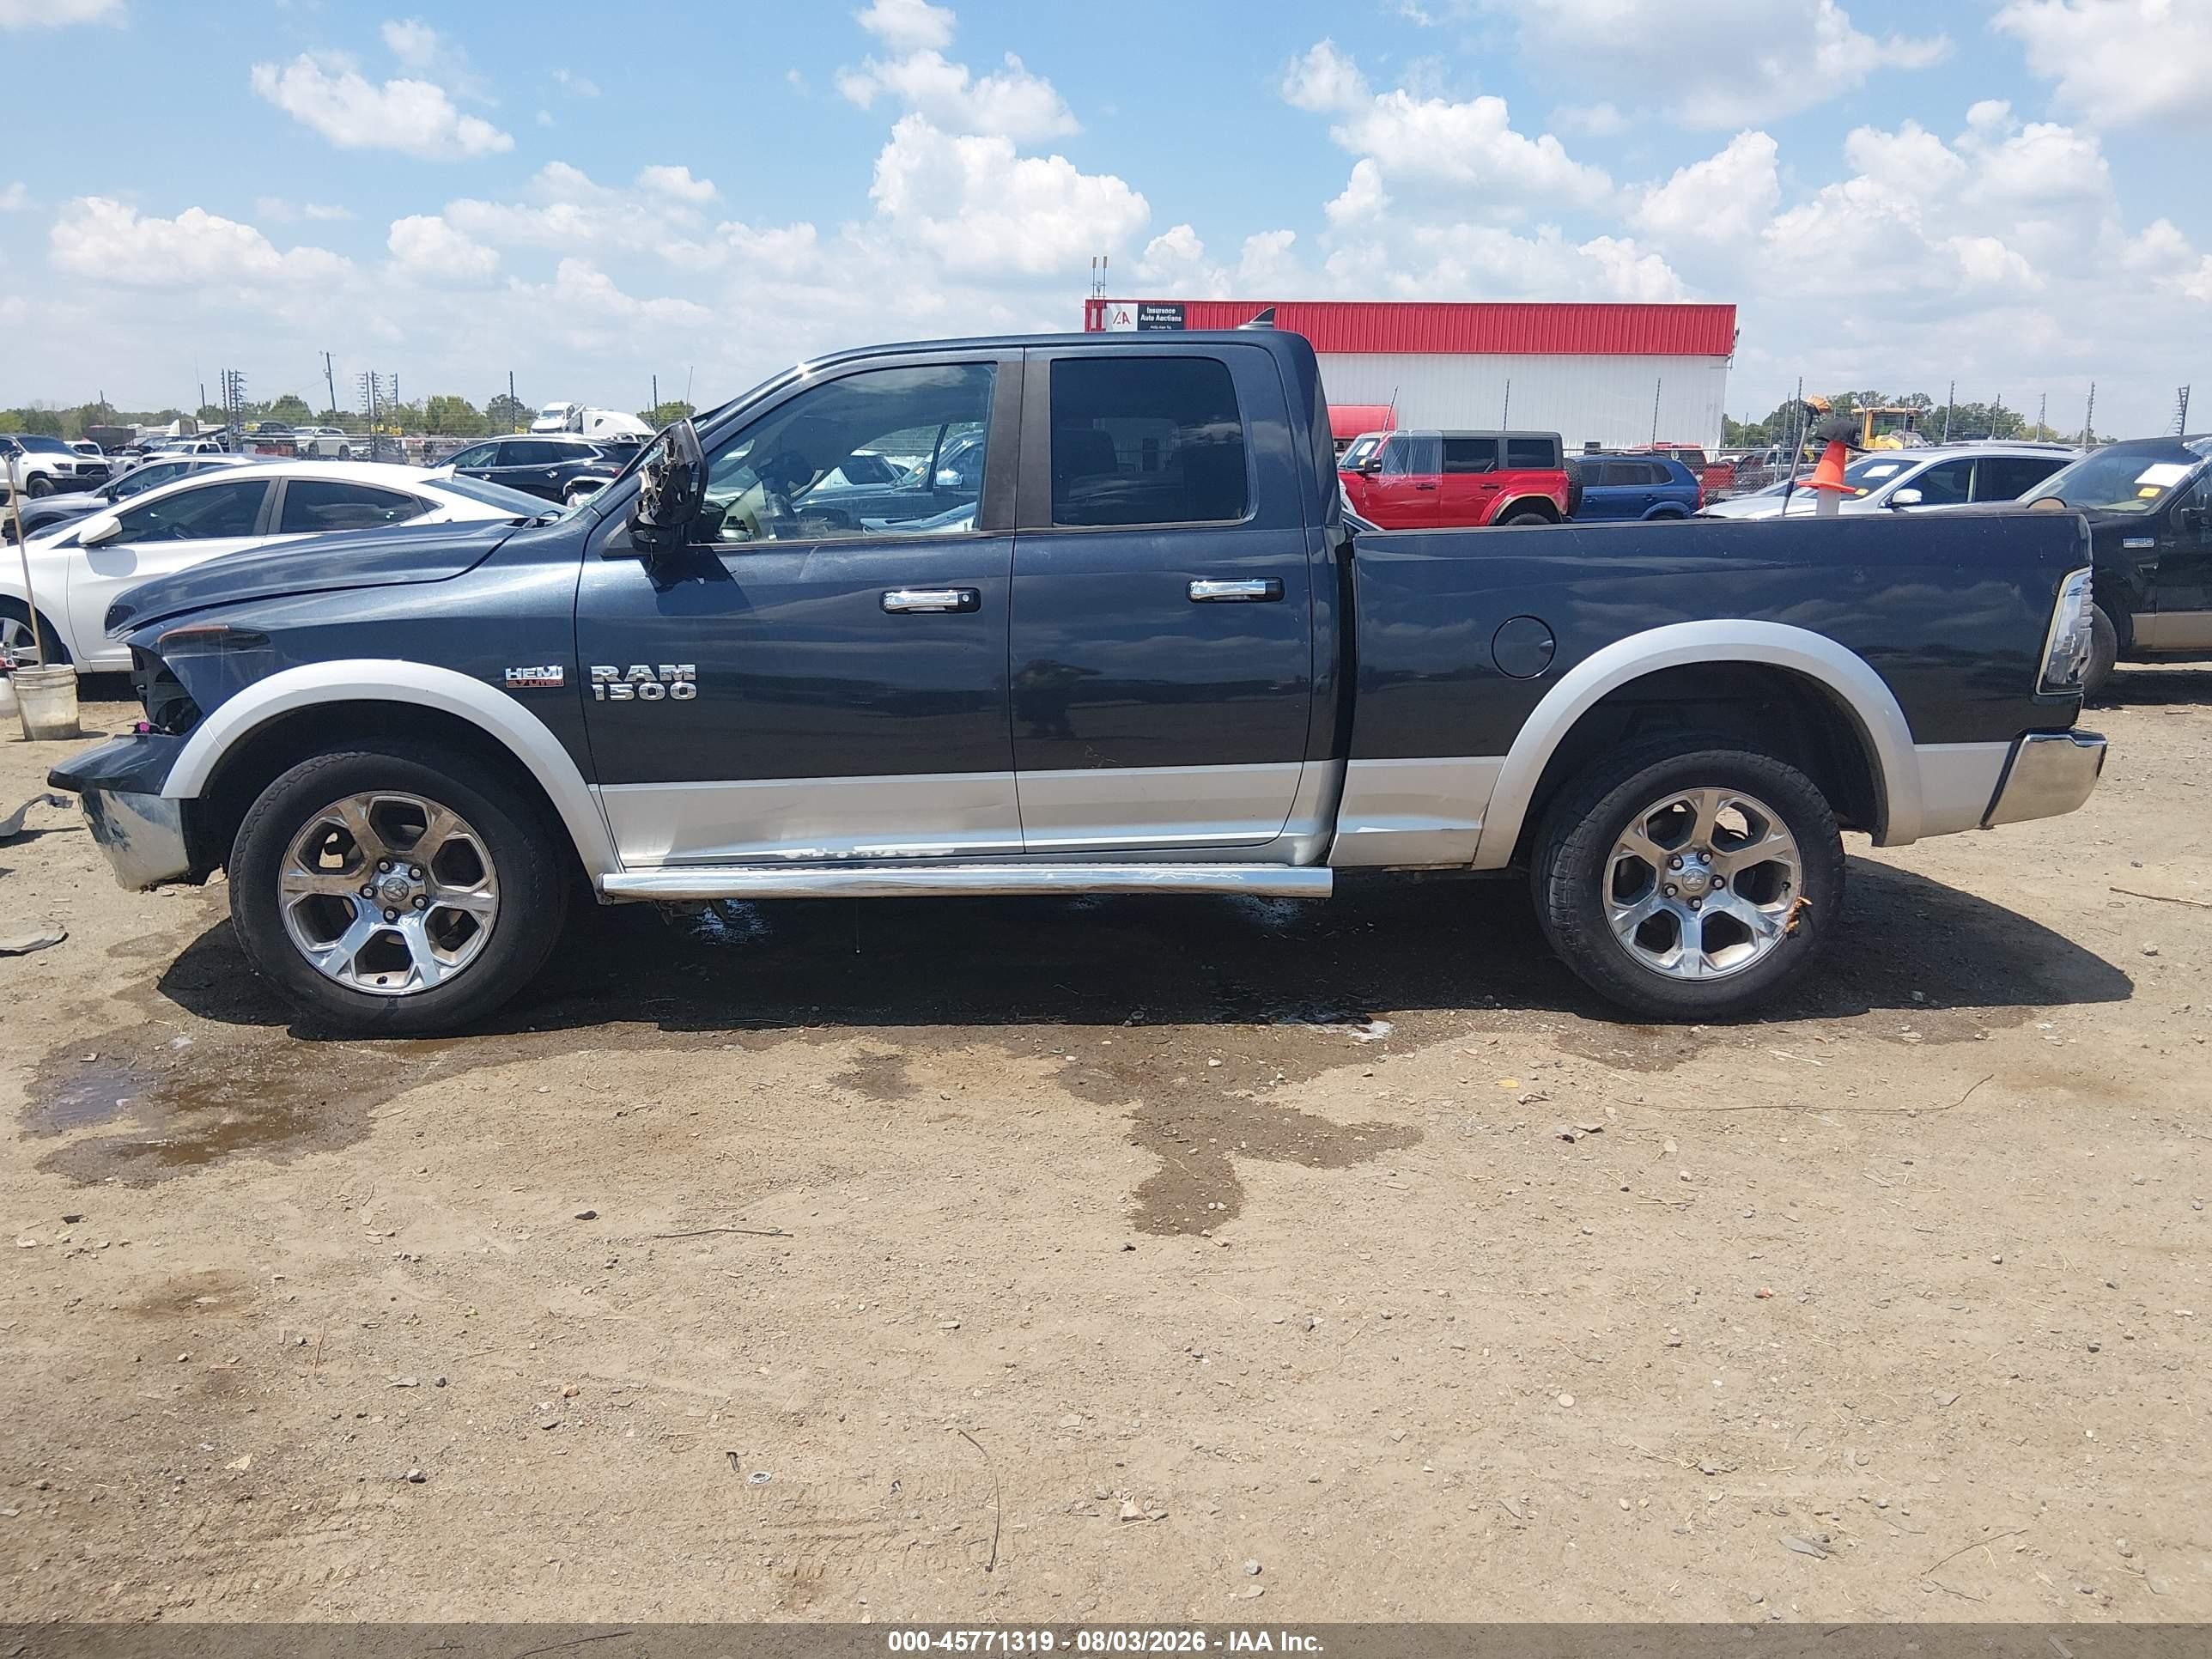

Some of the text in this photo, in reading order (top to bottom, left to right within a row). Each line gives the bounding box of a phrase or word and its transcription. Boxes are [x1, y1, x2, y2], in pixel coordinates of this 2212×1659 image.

[506, 665, 563, 679] HEMI
[591, 665, 696, 683] RAM
[591, 682, 696, 701] 1500
